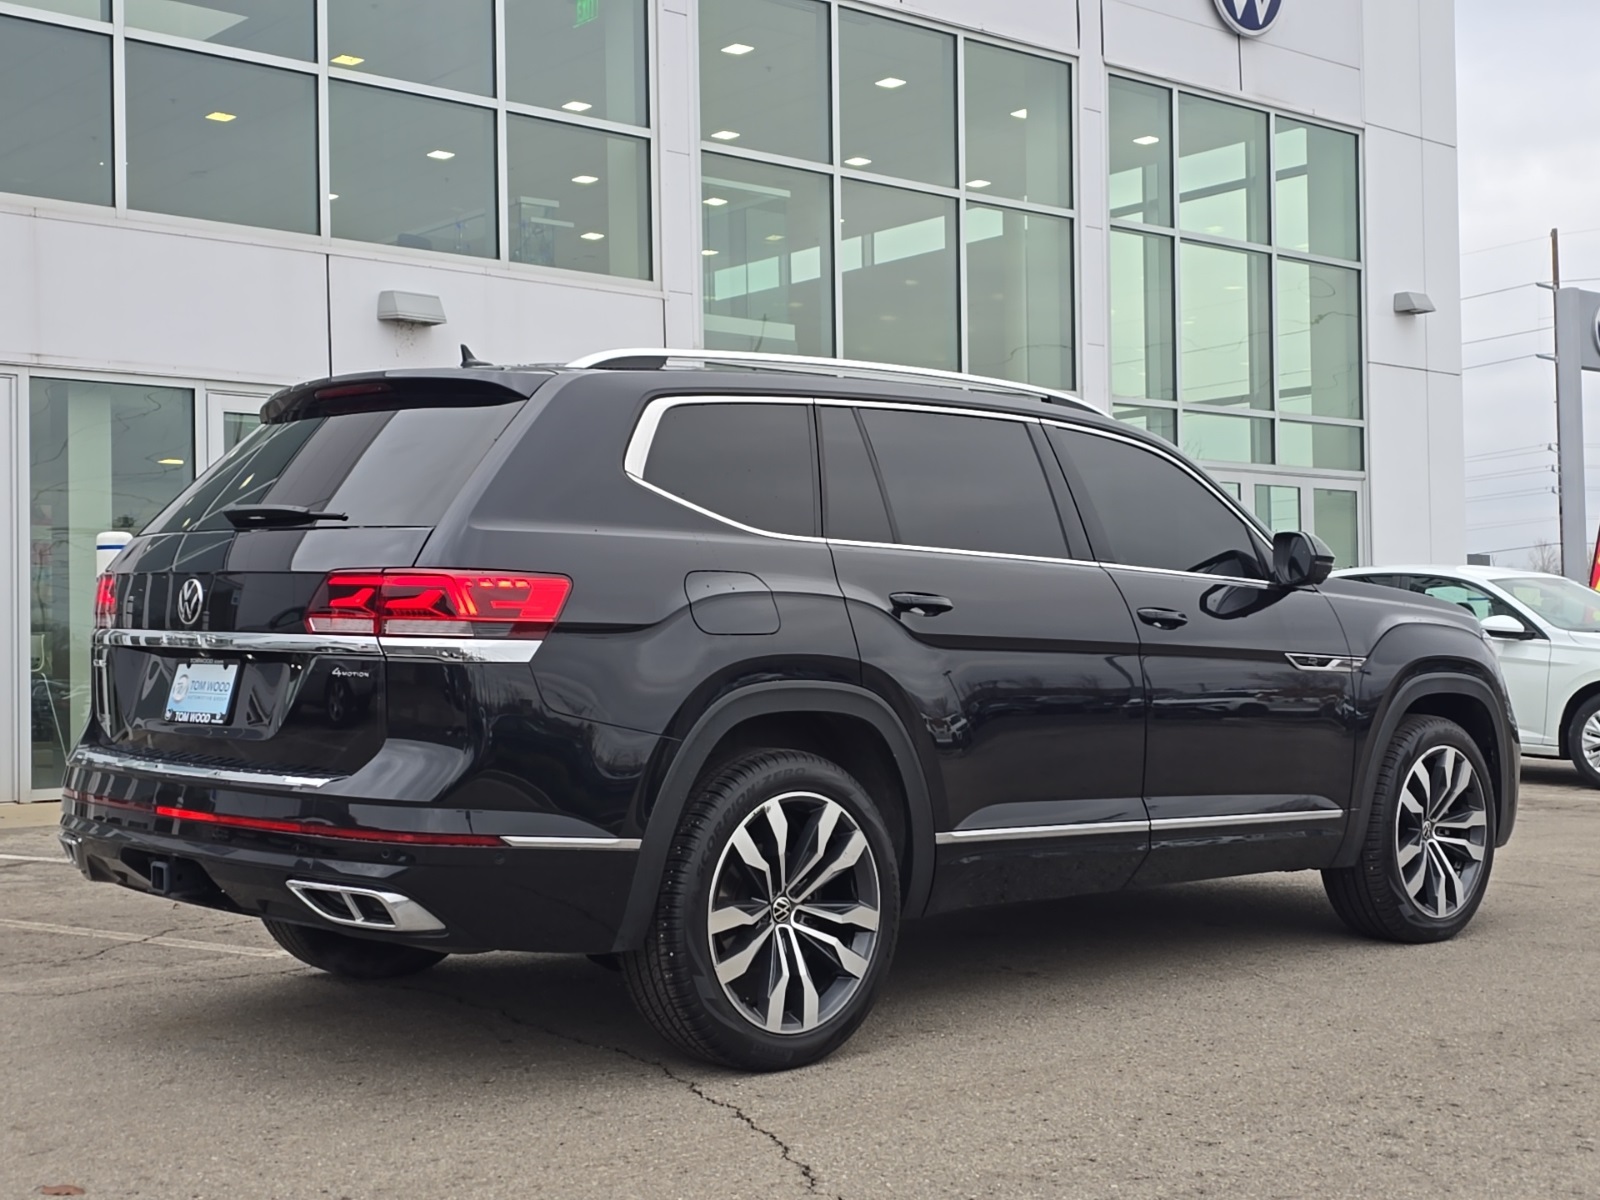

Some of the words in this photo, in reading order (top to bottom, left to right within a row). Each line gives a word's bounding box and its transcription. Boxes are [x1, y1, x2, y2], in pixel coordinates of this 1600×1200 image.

[190, 680, 206, 690] TOM
[207, 681, 230, 692] WOOD
[175, 711, 189, 722] TOM
[190, 712, 211, 723] WOOD
